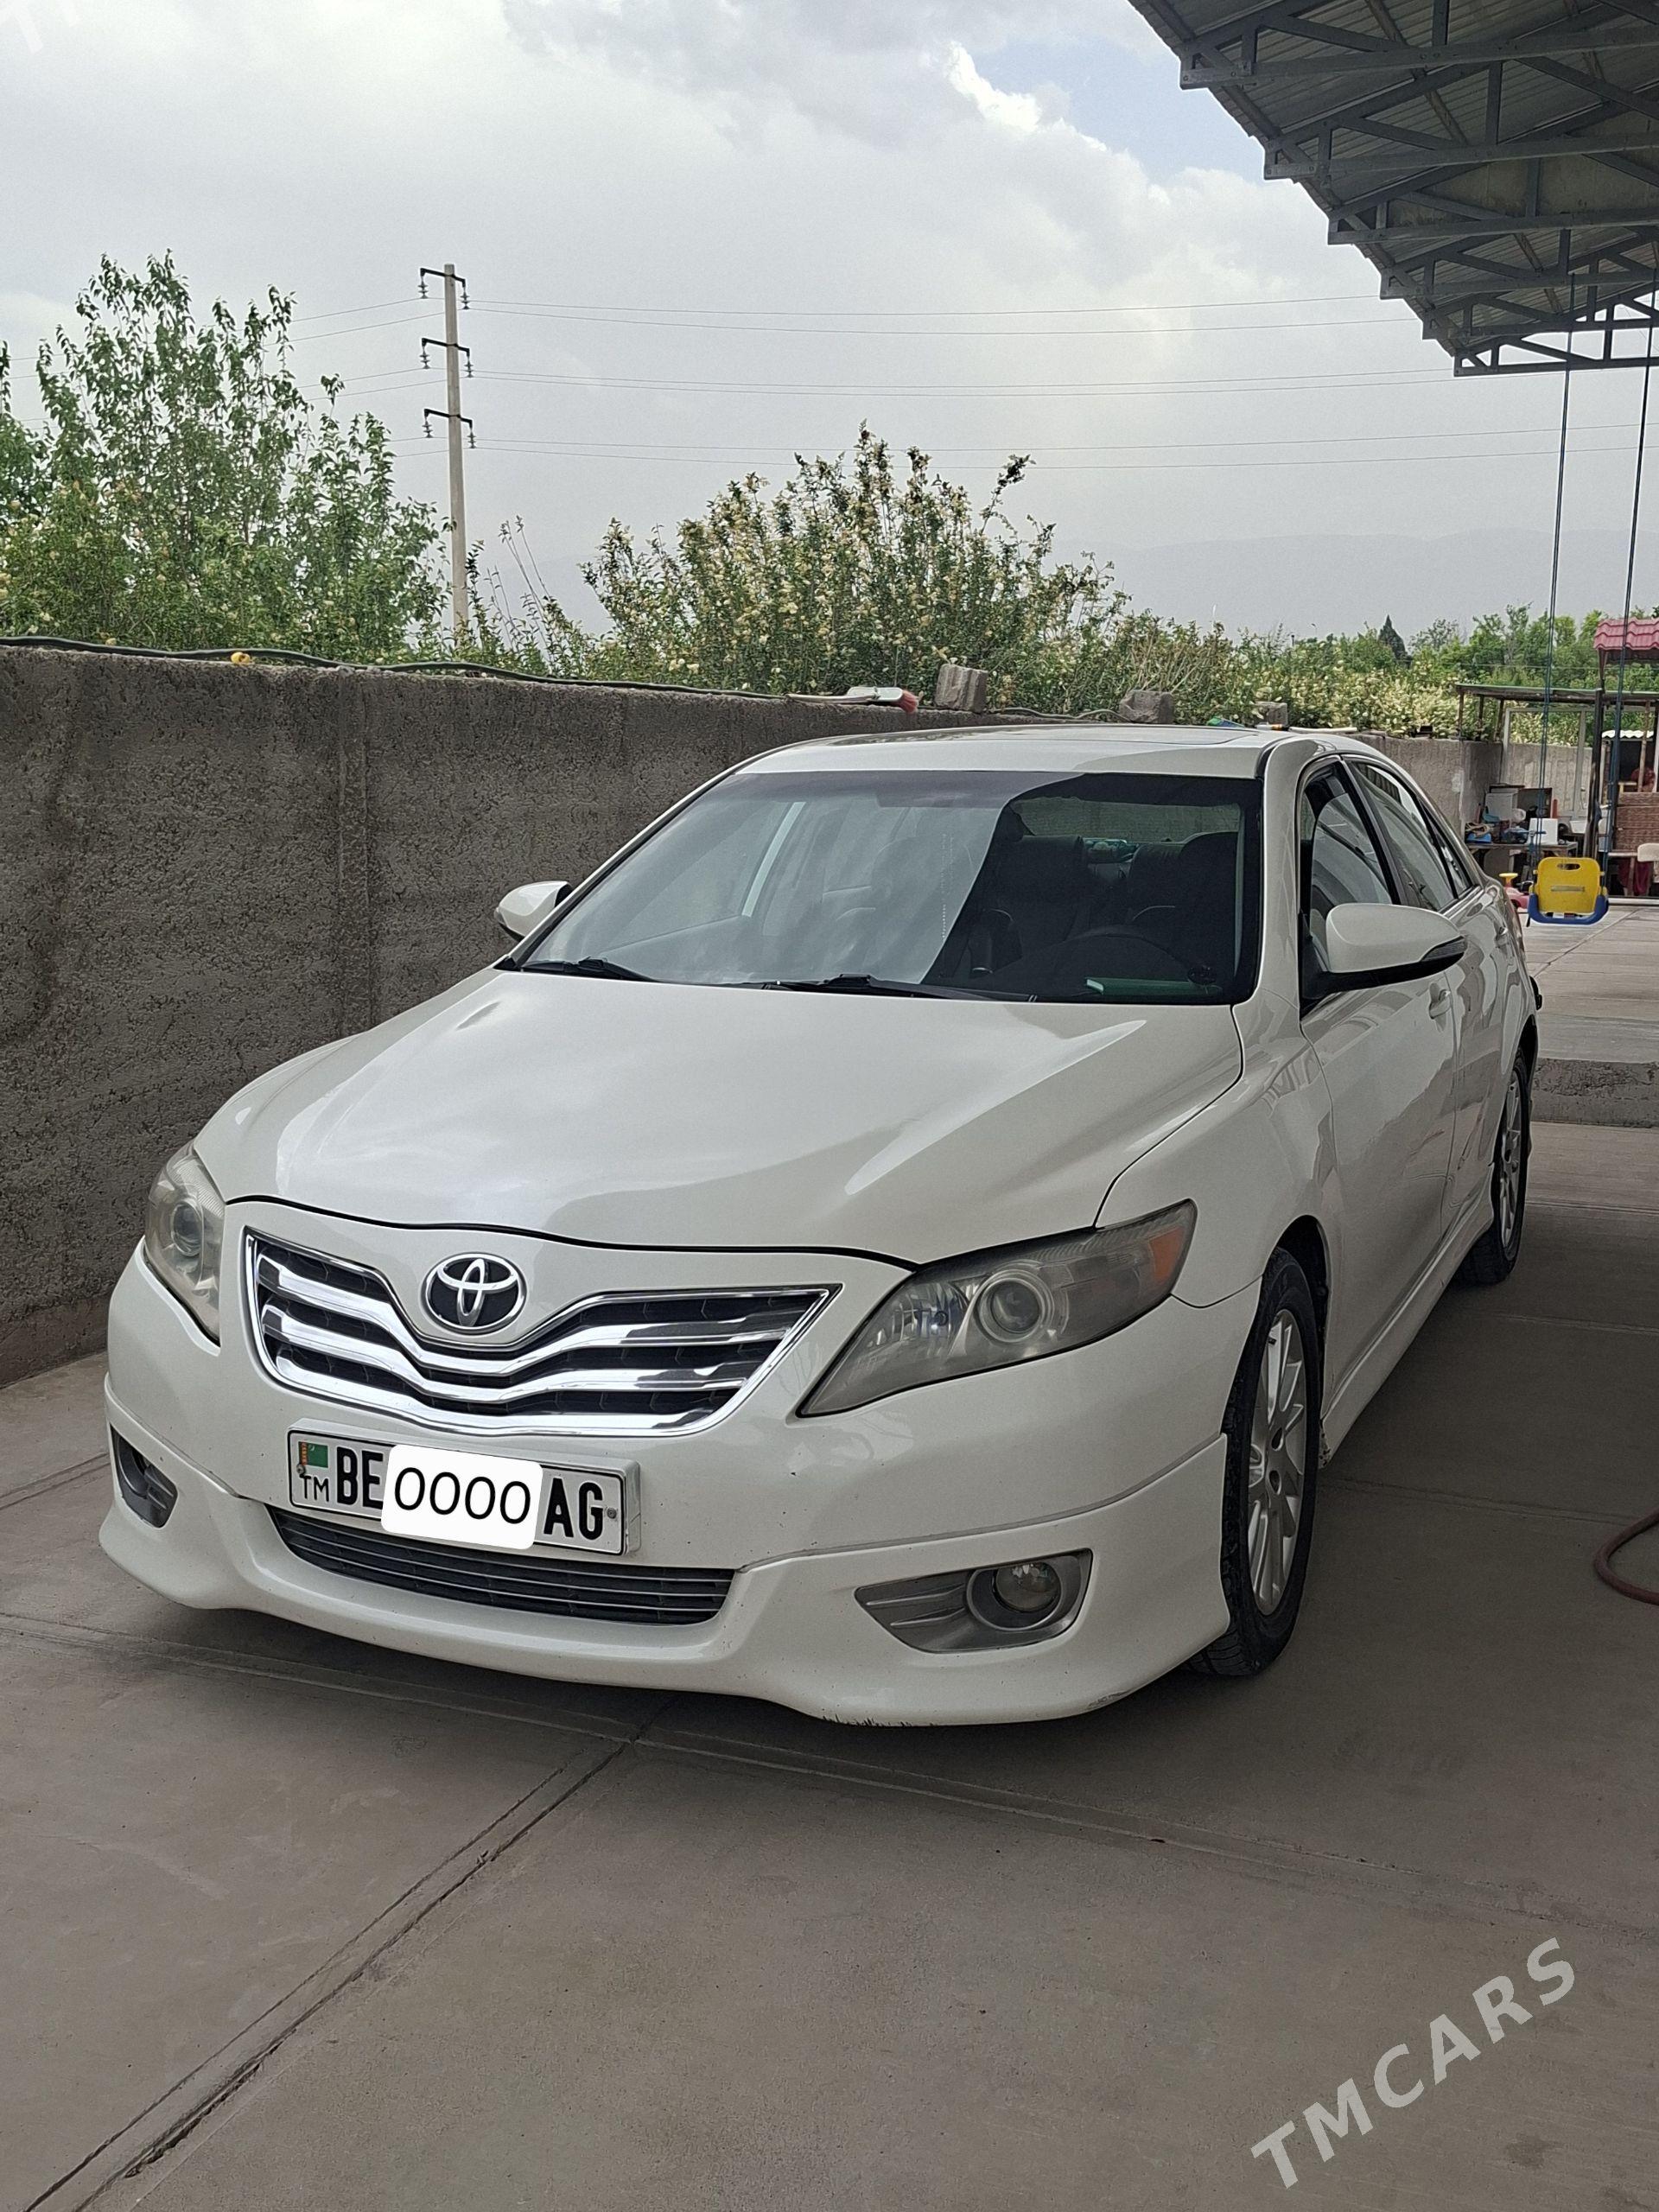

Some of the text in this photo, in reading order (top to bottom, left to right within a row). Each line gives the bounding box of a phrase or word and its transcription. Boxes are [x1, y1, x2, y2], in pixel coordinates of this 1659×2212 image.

[300, 1446, 383, 1510] TM BE
[543, 1478, 603, 1540] AG
